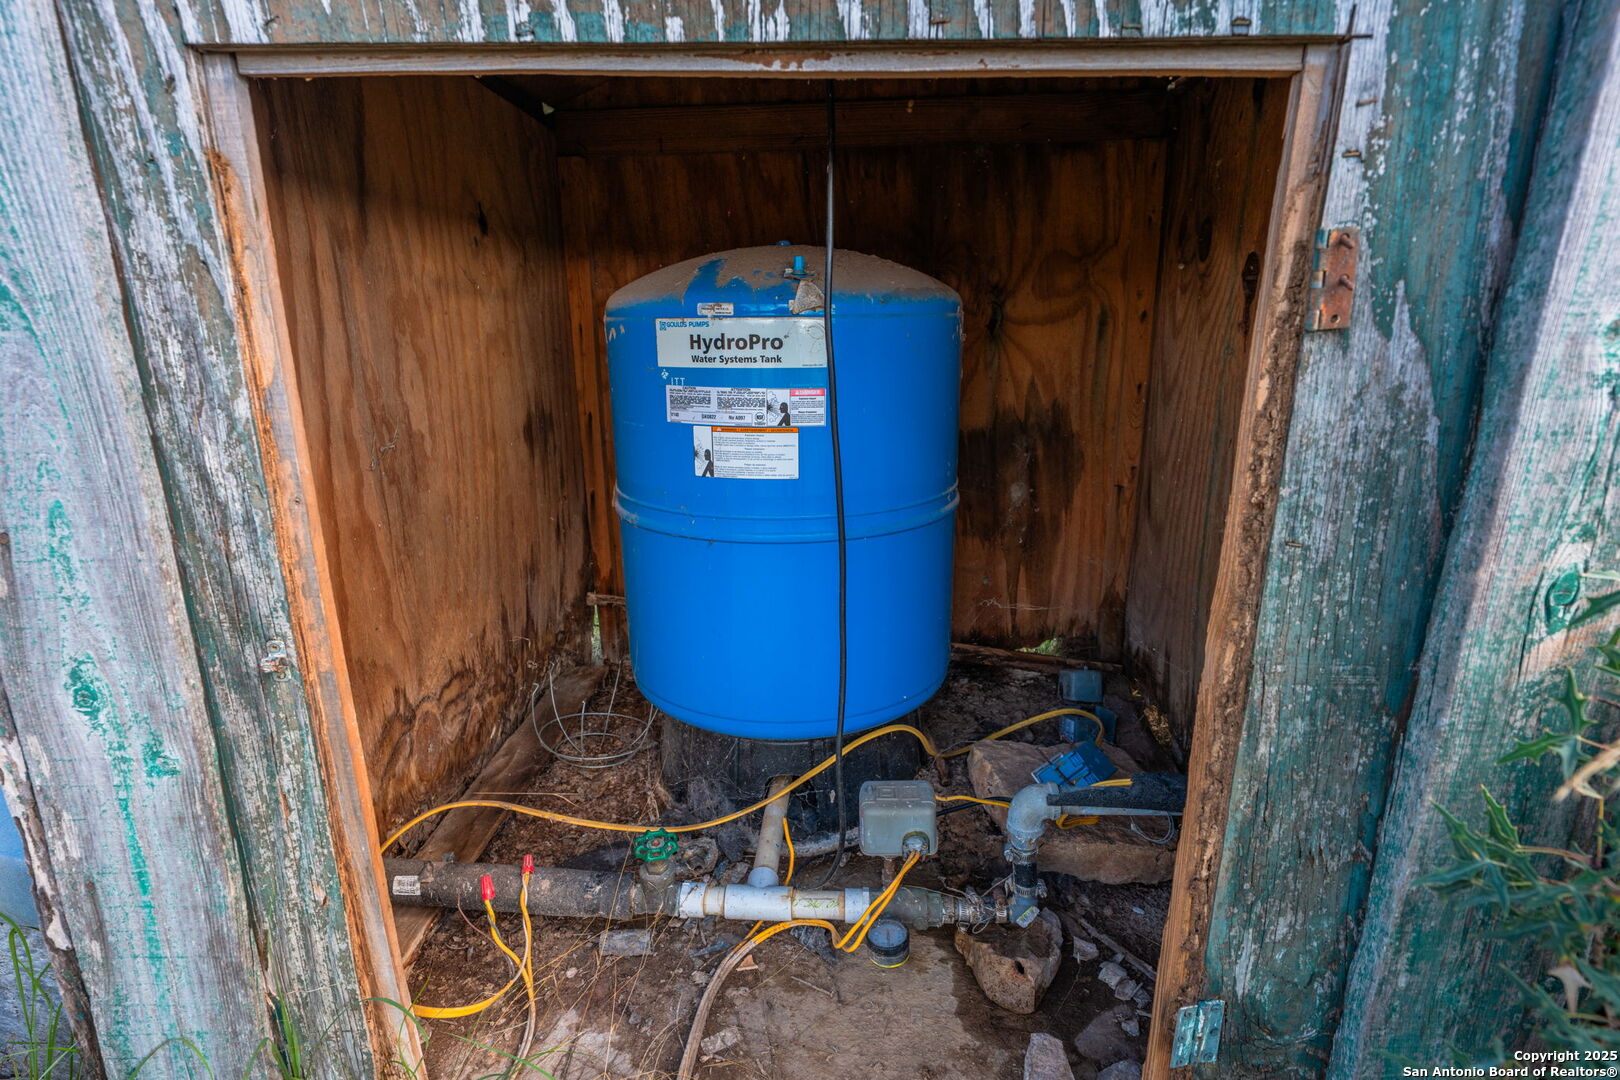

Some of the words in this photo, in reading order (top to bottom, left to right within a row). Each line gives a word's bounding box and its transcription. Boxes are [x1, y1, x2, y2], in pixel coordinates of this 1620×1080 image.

[689, 333, 784, 354] HydroPro
[691, 355, 717, 363] Water
[719, 355, 758, 365] Systems
[760, 355, 782, 364] Tank
